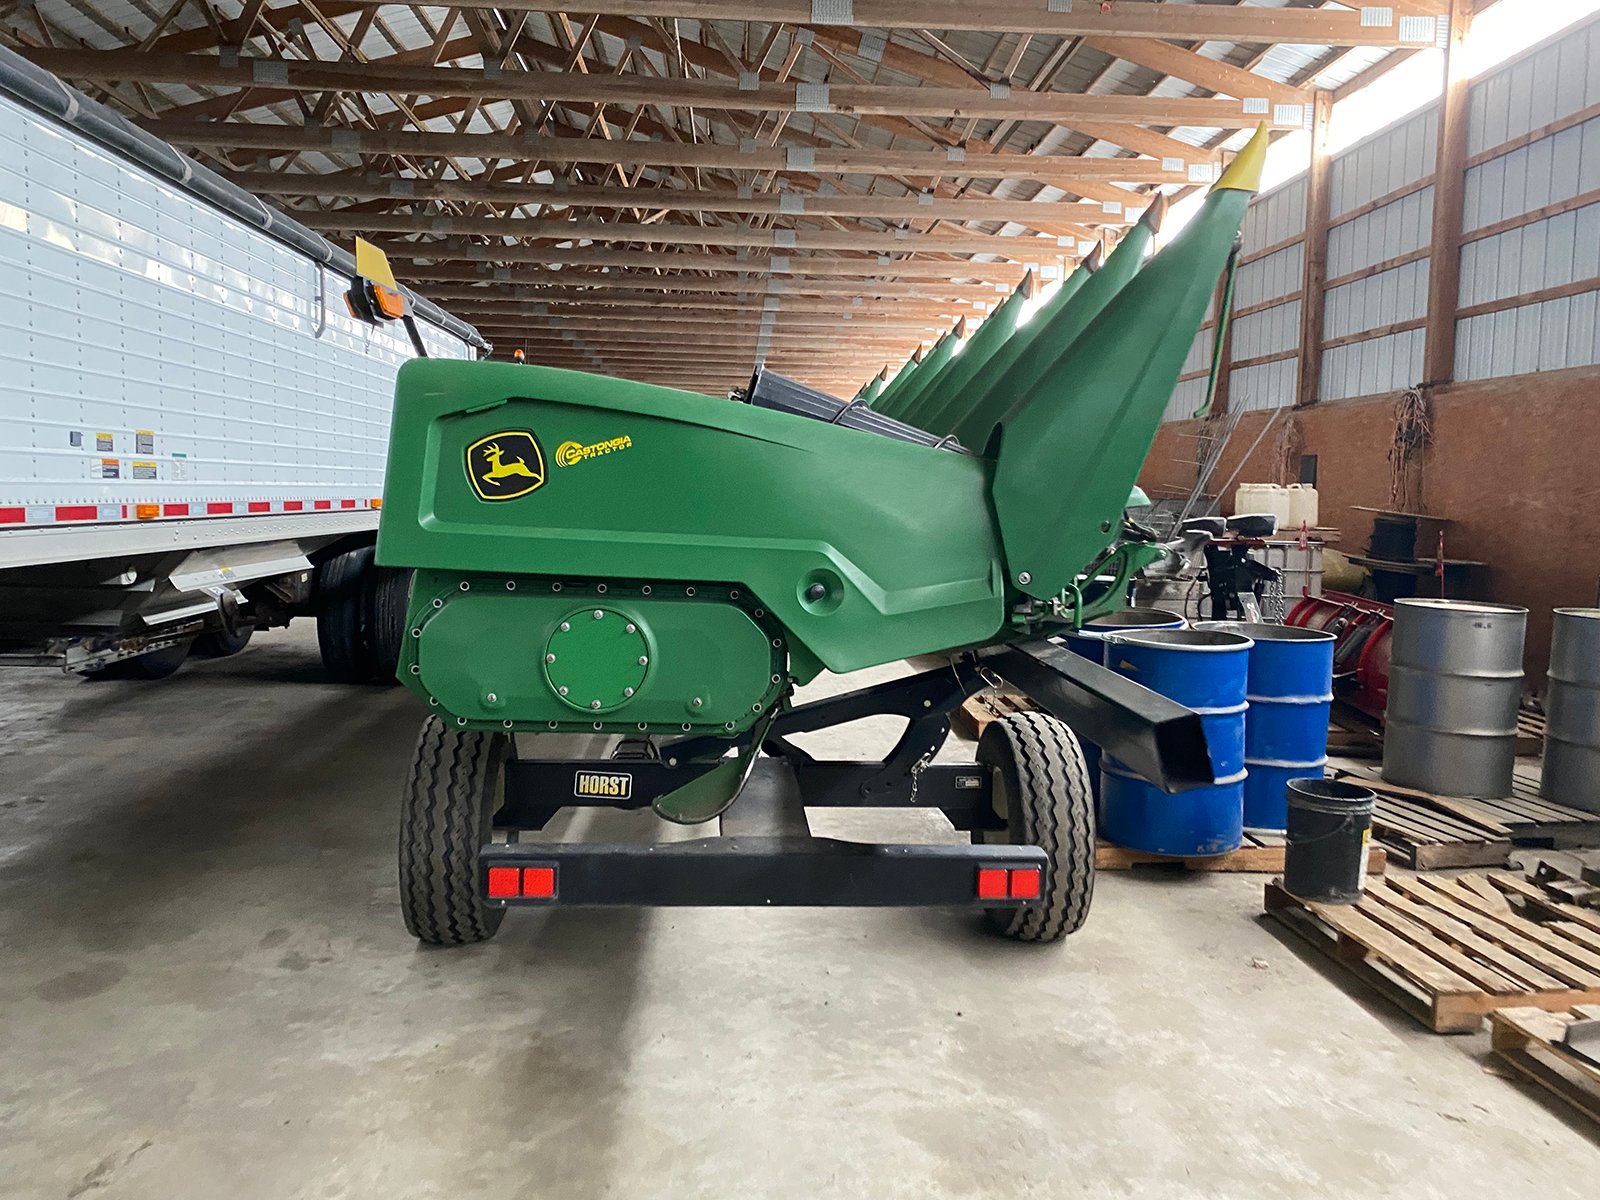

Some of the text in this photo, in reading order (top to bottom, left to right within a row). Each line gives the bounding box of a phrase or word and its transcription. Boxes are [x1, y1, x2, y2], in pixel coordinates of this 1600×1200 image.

[565, 435, 631, 460] CASTONGIA
[584, 442, 632, 460] TRACTOR
[578, 774, 629, 796] HORST
